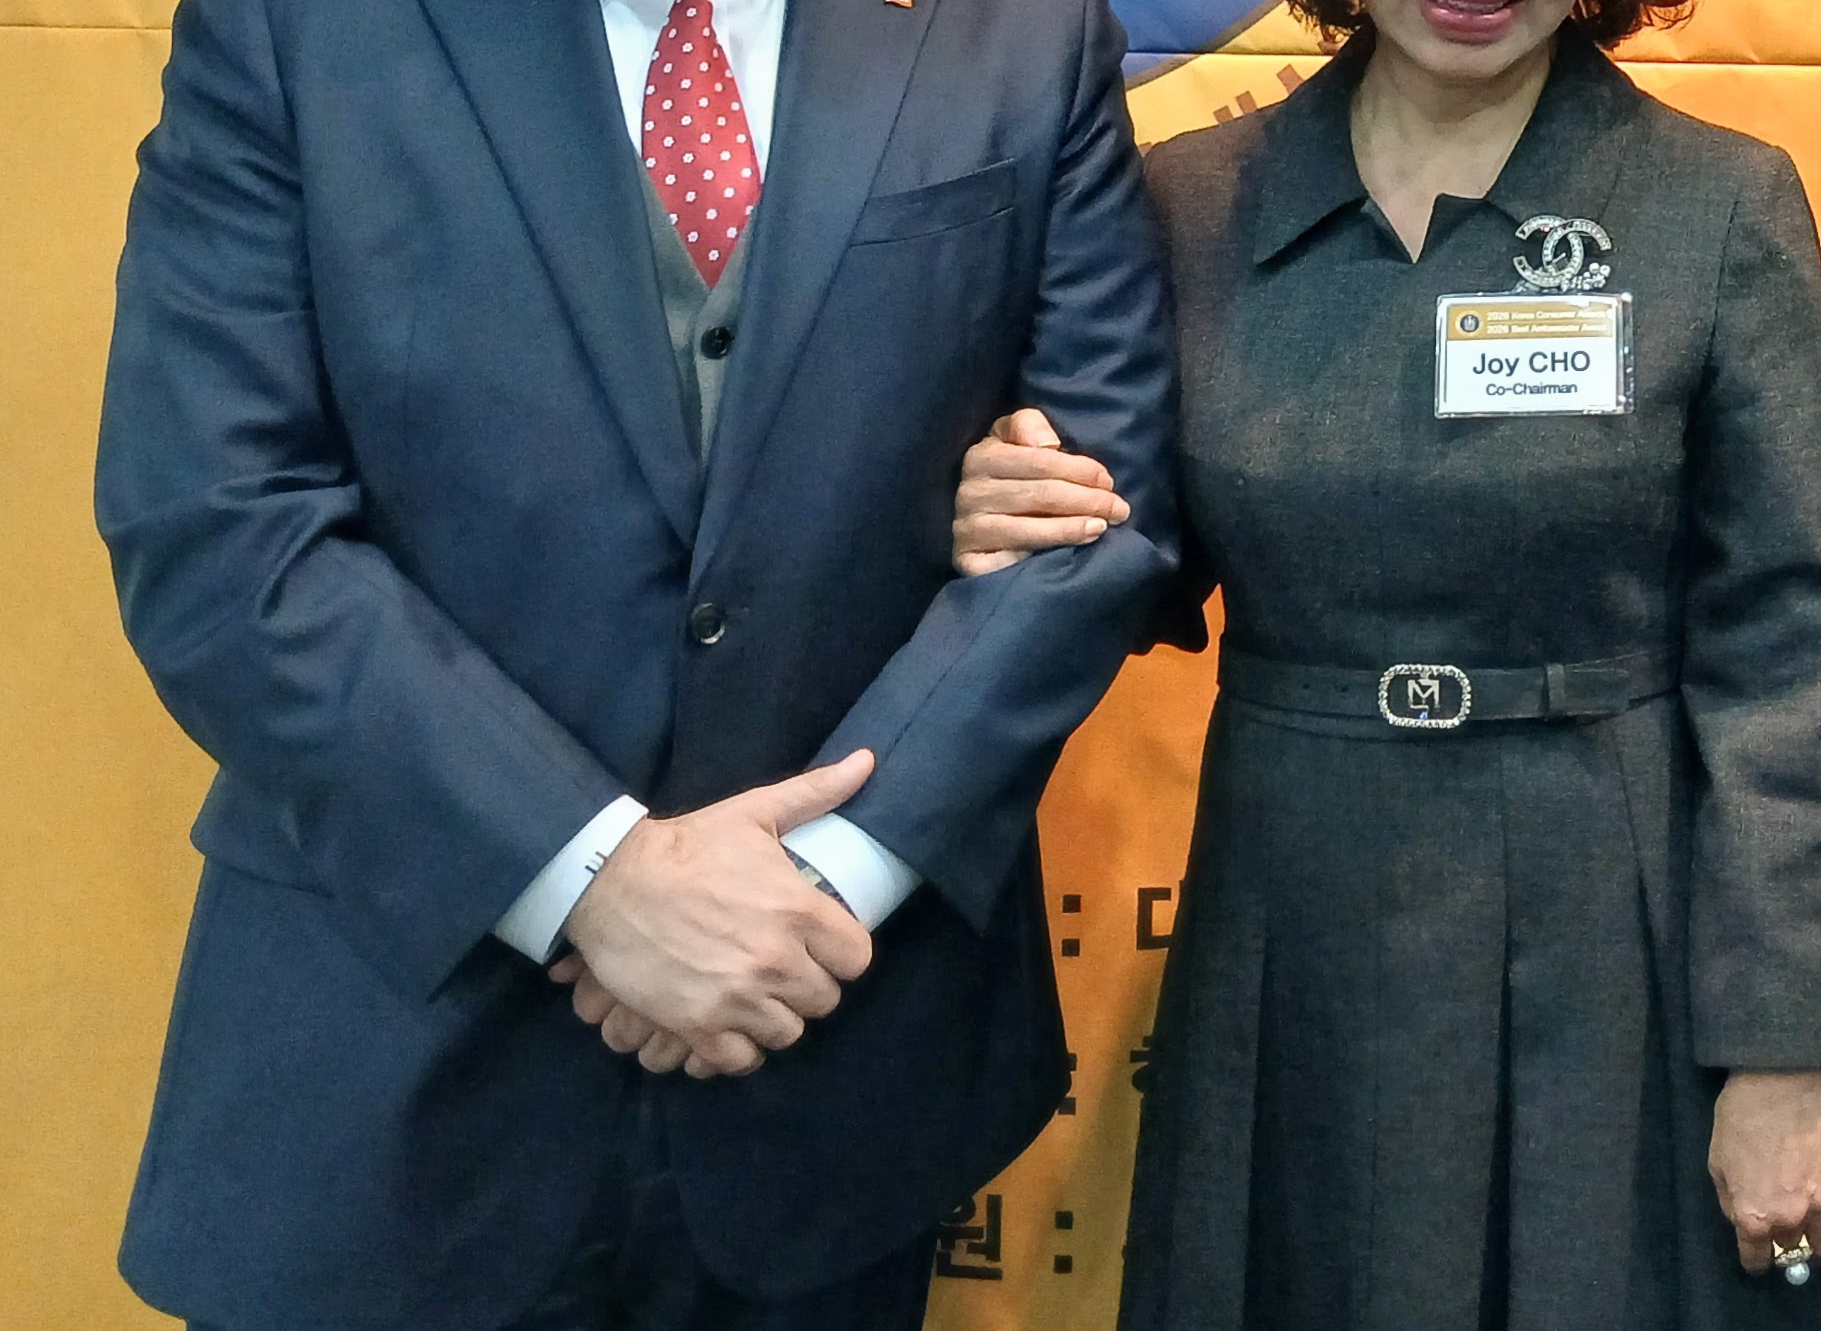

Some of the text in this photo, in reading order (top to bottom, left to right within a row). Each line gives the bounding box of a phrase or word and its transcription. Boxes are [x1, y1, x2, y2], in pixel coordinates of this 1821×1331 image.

[1473, 351, 1591, 376] Joy CHO
[1486, 383, 1578, 396] Co-Chairman
